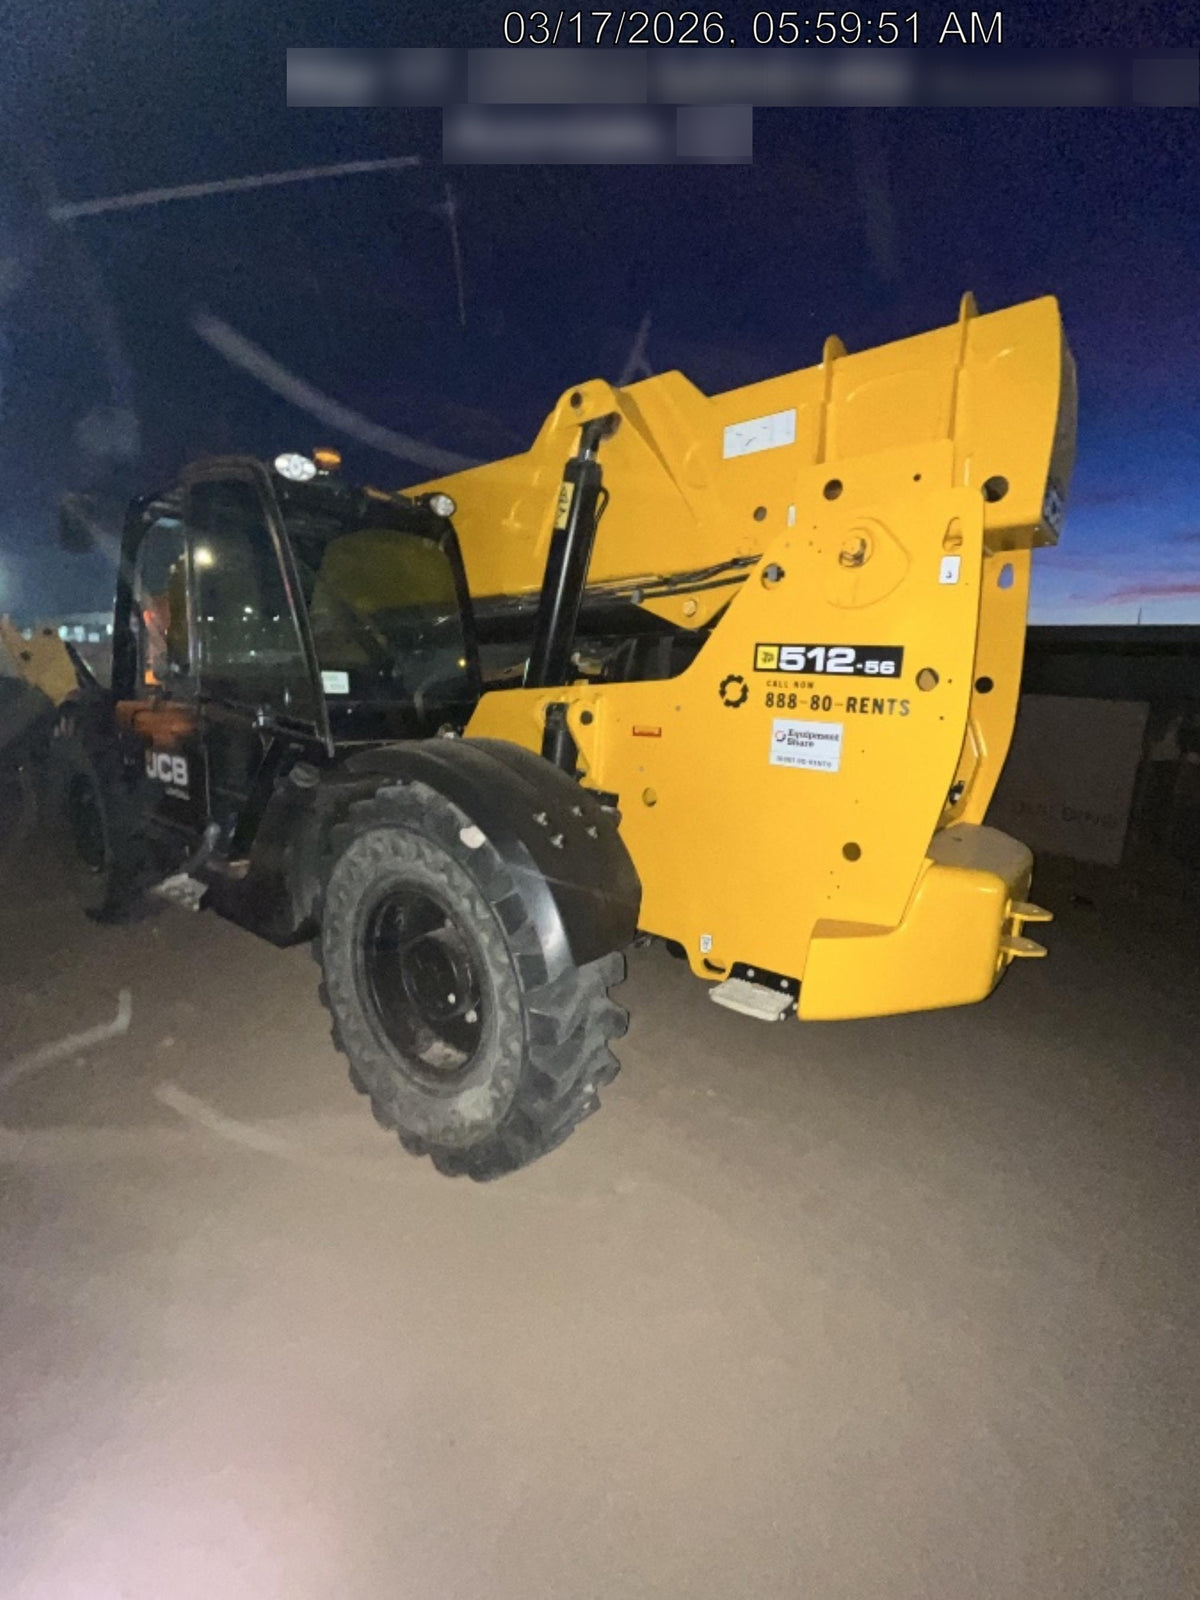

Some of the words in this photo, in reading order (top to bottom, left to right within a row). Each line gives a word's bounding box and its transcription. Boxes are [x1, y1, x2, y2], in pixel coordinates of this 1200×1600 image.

[779, 646, 896, 675] 512-56
[766, 680, 789, 689] CALL
[793, 680, 815, 689] NOW
[764, 692, 911, 717] 888-80-RENTS
[145, 751, 189, 786] JCB
